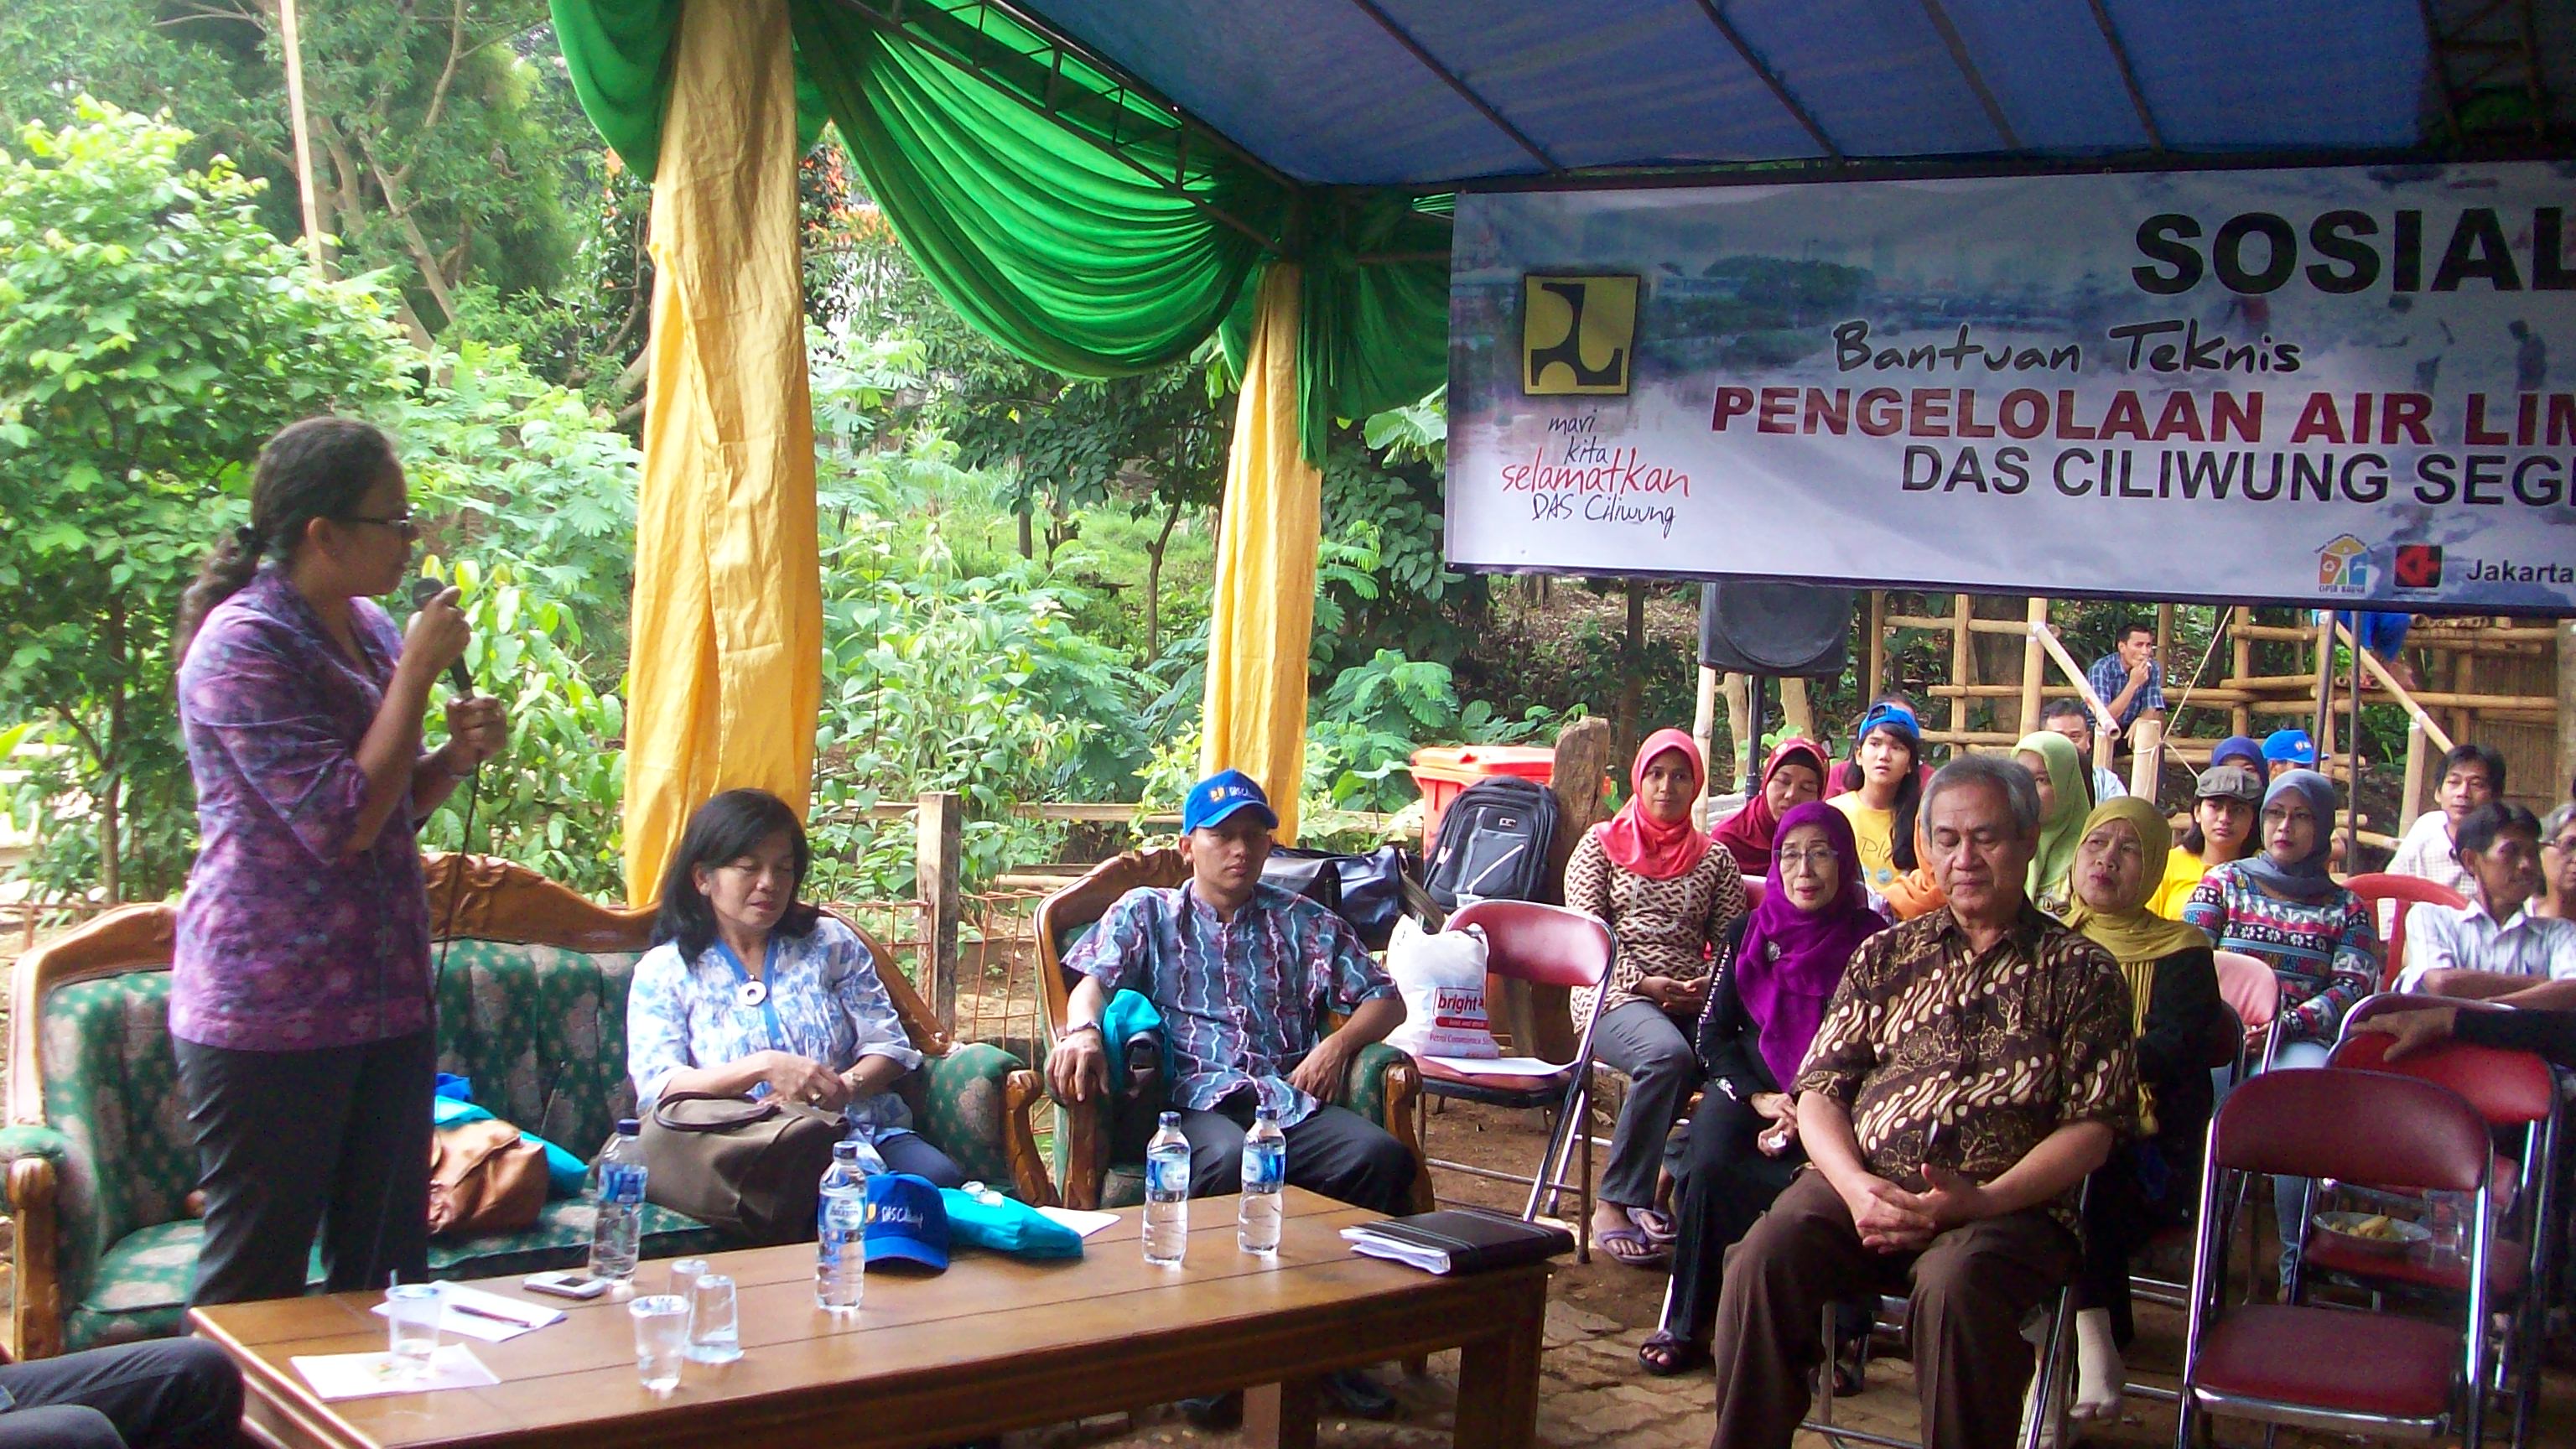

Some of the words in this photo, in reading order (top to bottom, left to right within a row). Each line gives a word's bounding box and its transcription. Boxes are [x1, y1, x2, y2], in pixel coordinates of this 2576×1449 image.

[1832, 319, 2080, 372] Bantuan
[2109, 318, 2301, 373] Teknis
[1548, 408, 1597, 434] mari
[1711, 387, 2264, 442] PENGELOLAAN
[2290, 392, 2433, 445] AIR
[1502, 446, 1690, 497] selamatkan
[1564, 435, 1608, 465] kita
[1901, 444, 2030, 495] DAS
[2052, 446, 2389, 503] CILIWUNG
[2413, 453, 2576, 506] SEG
[1531, 492, 1575, 522] DAS
[1585, 493, 1676, 540] Ciliwung
[2466, 558, 2574, 584] Jakarta
[1437, 993, 1478, 1015] bright
